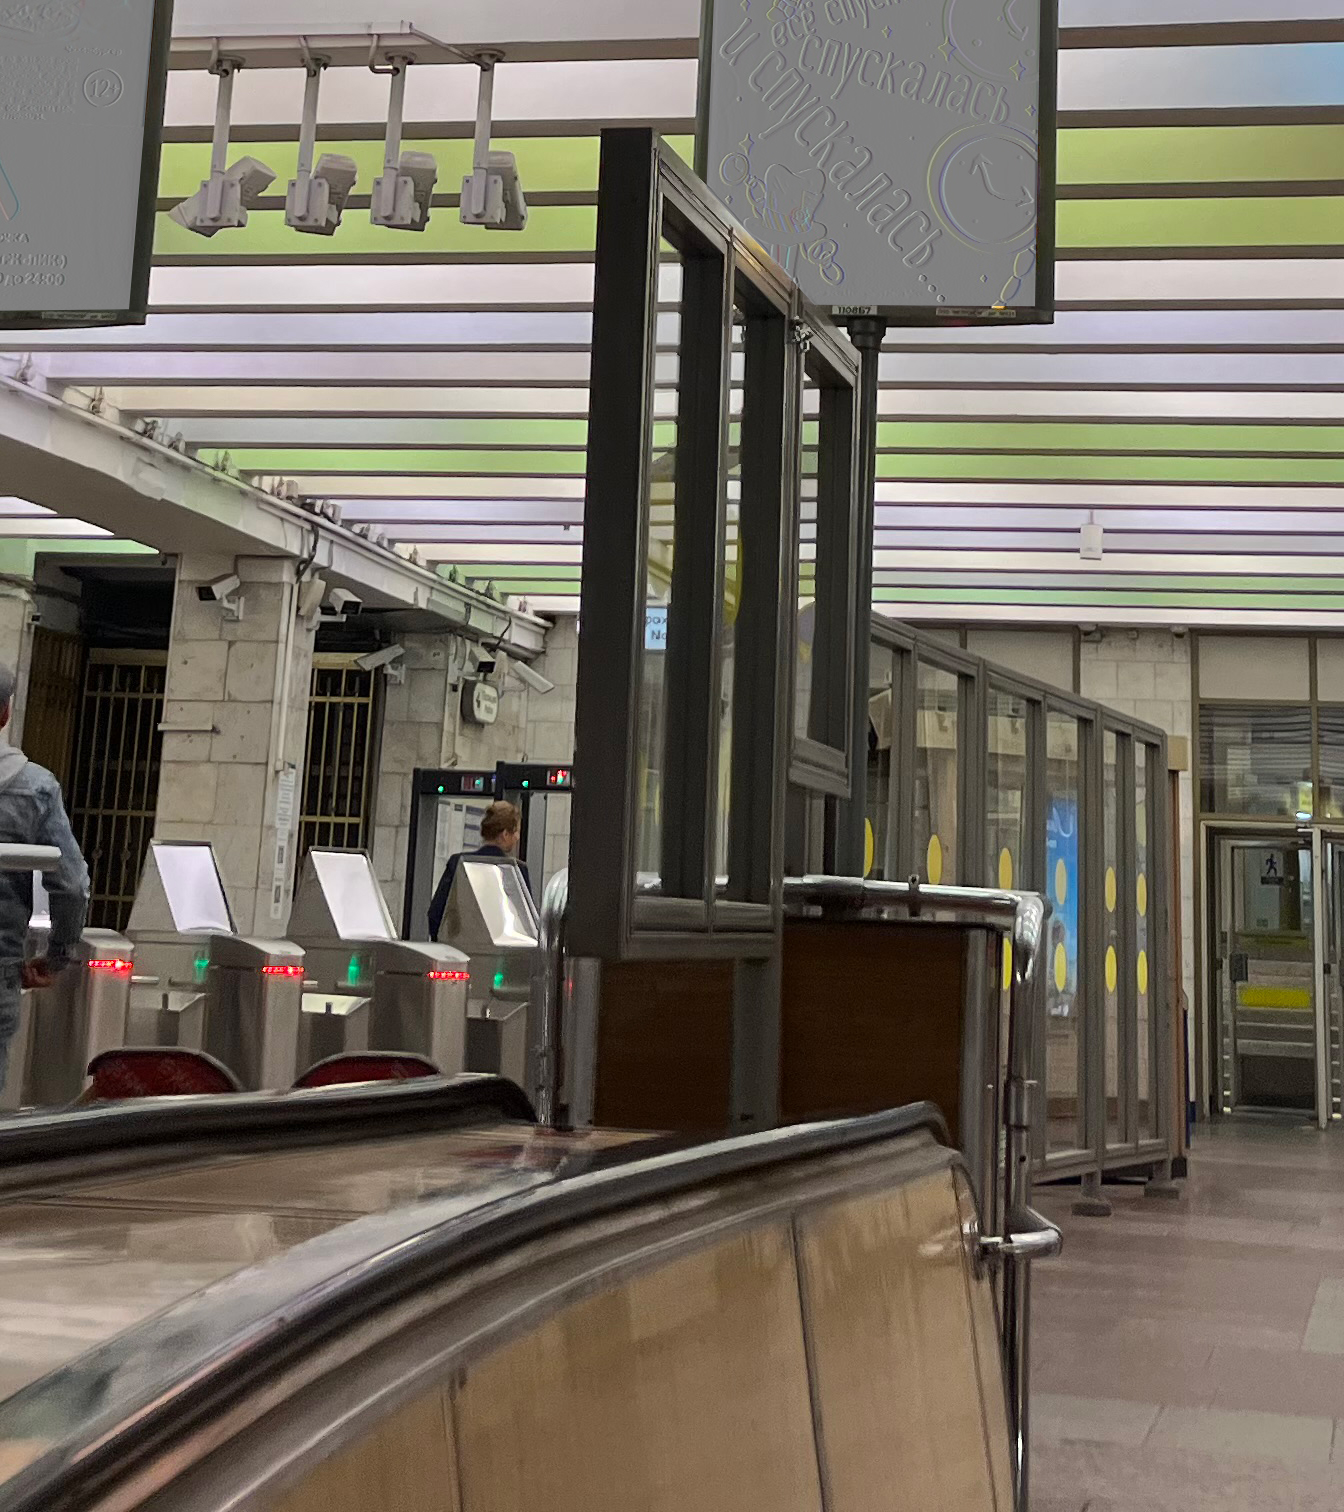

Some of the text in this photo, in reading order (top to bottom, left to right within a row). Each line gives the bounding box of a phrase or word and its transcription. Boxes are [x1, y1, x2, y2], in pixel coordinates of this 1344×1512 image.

[770, 1, 818, 48] всё
[90, 79, 118, 98] 12+
[798, 34, 1012, 126] спускалась
